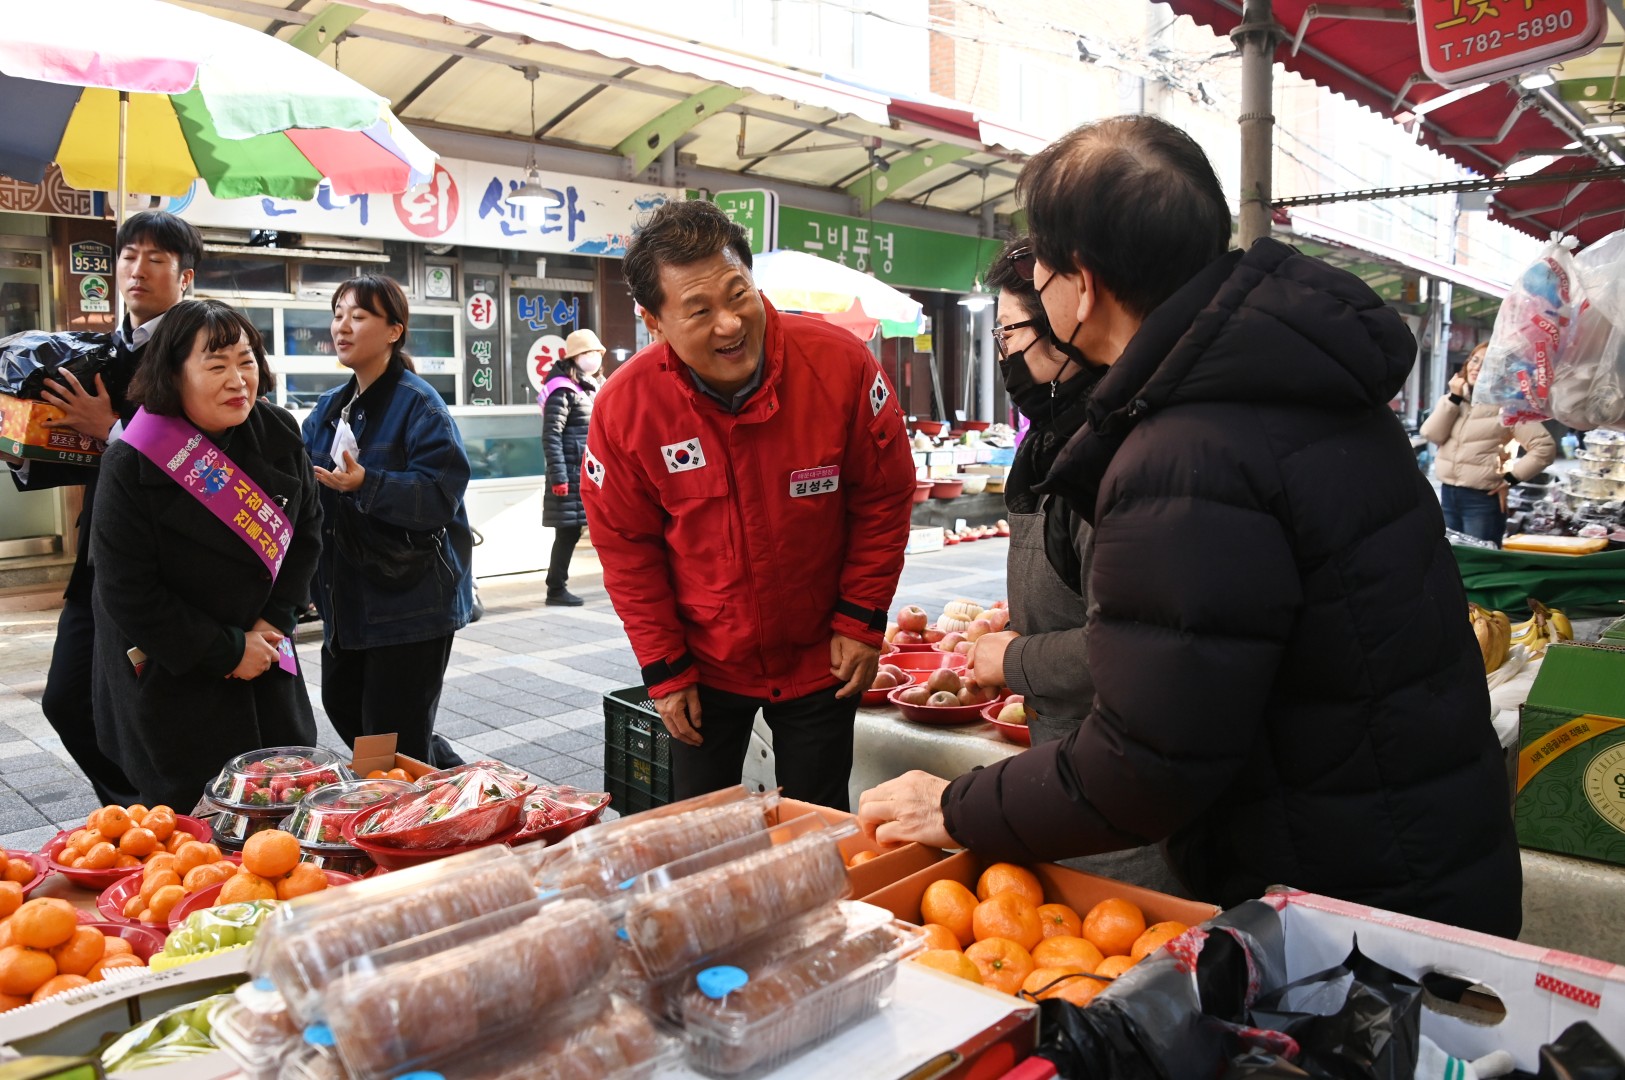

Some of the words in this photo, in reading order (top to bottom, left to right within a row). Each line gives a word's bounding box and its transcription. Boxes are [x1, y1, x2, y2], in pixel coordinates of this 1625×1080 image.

[1440, 9, 1573, 61] T.782-5890
[75, 256, 108, 271] 95-34
[471, 297, 492, 324] 회
[518, 295, 580, 332] 반여
[795, 478, 834, 495] 김성수
[233, 479, 283, 534] 시장에서
[233, 508, 279, 560] 전통시장
